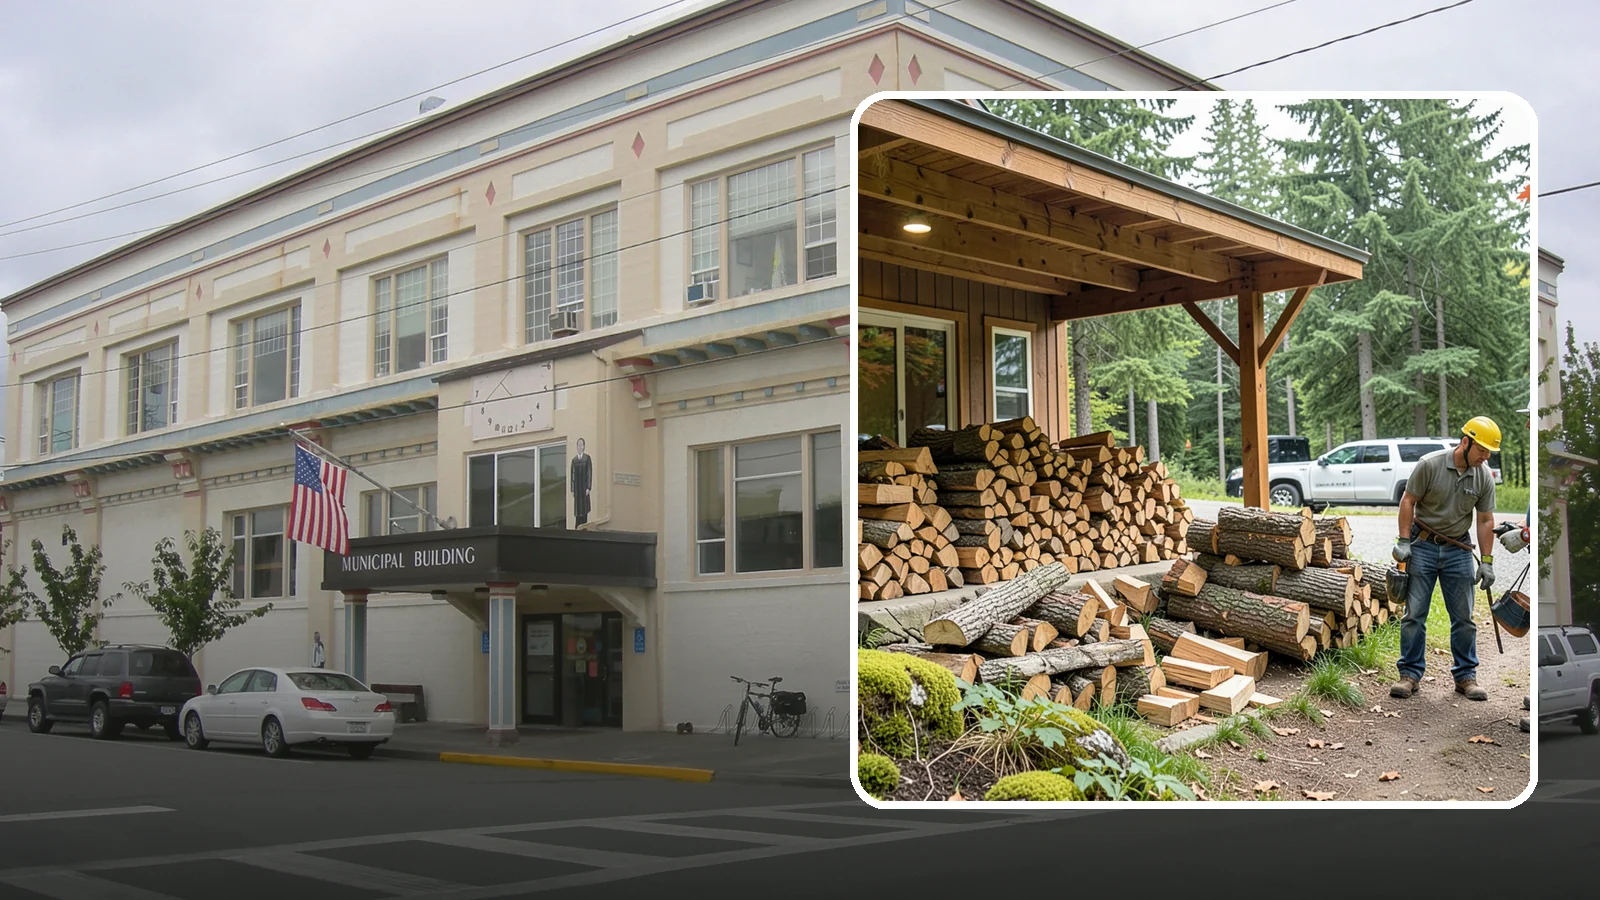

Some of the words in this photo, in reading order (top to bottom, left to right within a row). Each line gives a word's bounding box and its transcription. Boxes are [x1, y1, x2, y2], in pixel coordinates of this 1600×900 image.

[547, 361, 551, 370] 6
[476, 390, 479, 398] 7
[536, 402, 540, 410] 4
[480, 407, 485, 415] 8
[488, 418, 492, 426] 9
[528, 414, 533, 422] 3
[494, 424, 500, 432] 10
[521, 420, 526, 428] 2
[342, 552, 405, 572] MUNICIPAL
[414, 546, 475, 567] BUILDING
